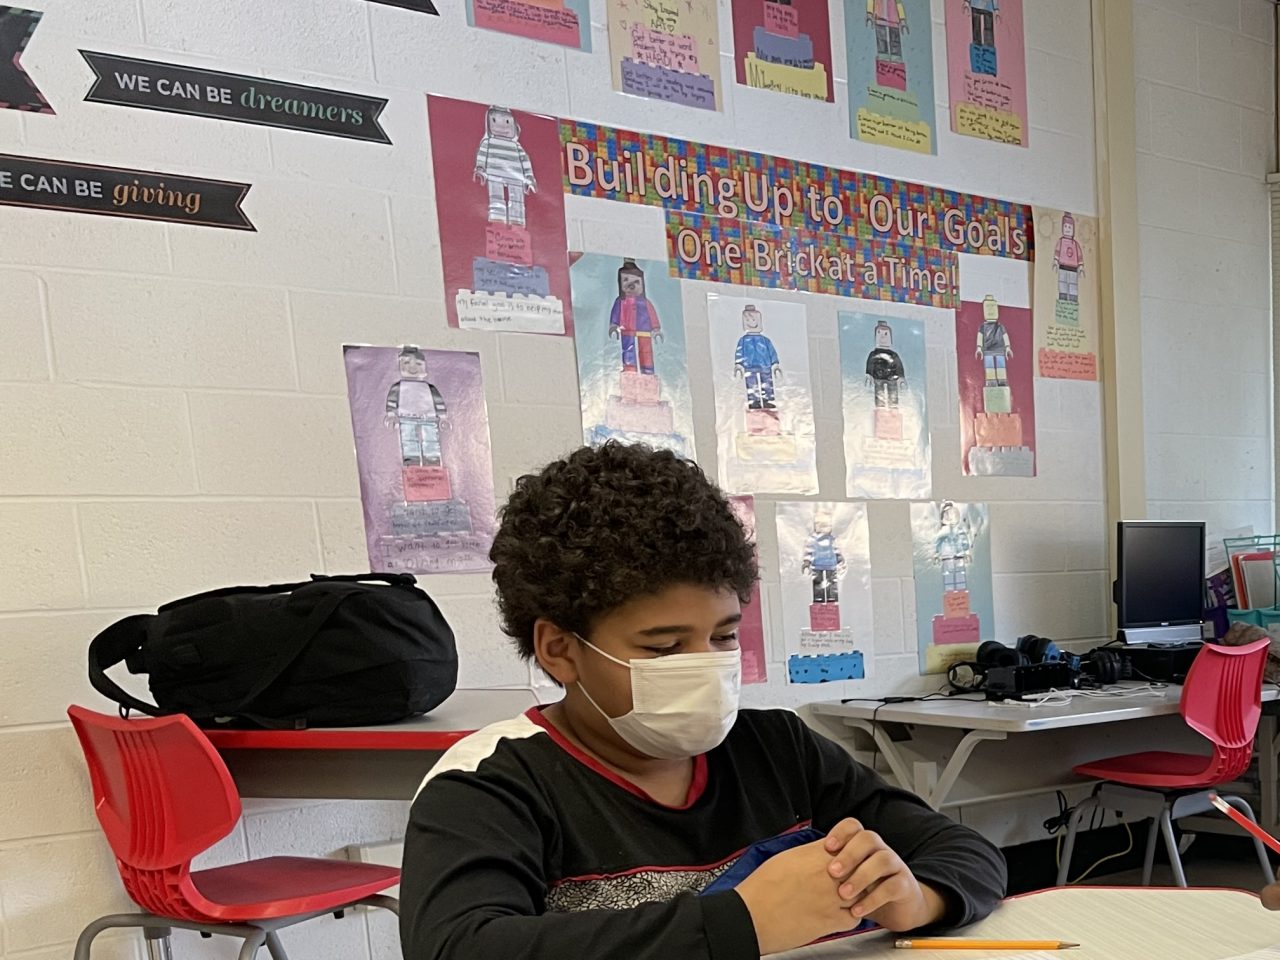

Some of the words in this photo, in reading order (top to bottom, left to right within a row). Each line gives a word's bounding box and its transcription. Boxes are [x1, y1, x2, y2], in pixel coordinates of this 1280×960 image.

[115, 72, 151, 93] WE
[156, 79, 200, 100] CAN
[206, 86, 233, 105] BE
[240, 86, 363, 126] dreamers
[20, 174, 67, 195] CAN
[75, 180, 103, 198] BE
[113, 180, 201, 214] giving
[566, 142, 738, 219] Building
[743, 171, 794, 225] Up
[807, 184, 843, 226] to
[868, 194, 928, 238] Our
[943, 208, 1025, 256] Goals
[676, 229, 742, 268] One
[753, 238, 825, 279] Brick
[828, 255, 855, 283] at
[864, 265, 878, 285] a
[882, 255, 958, 296] Time!
